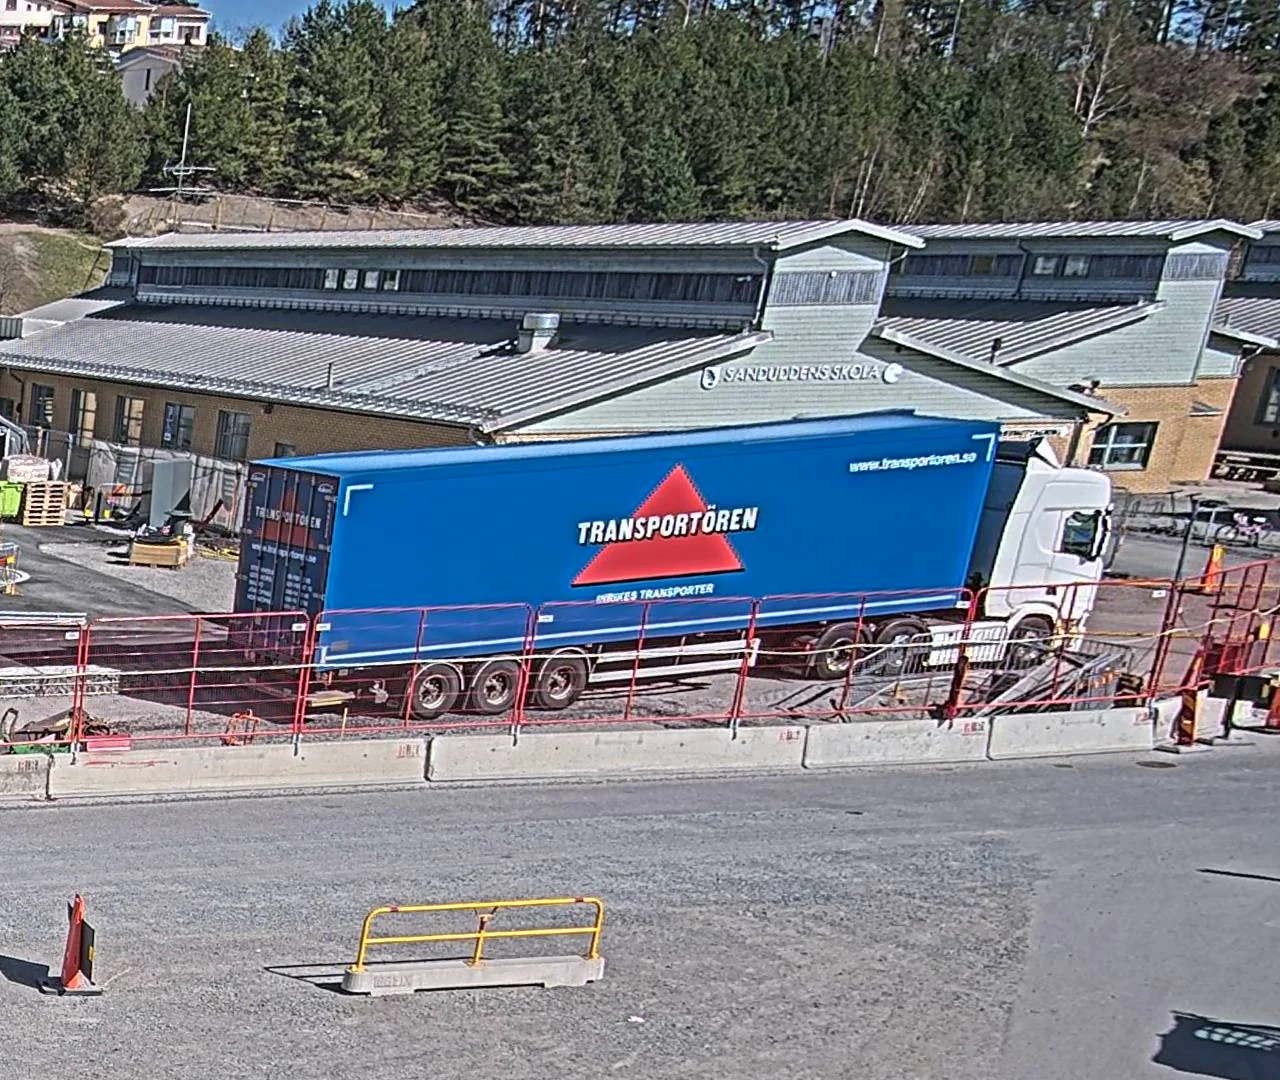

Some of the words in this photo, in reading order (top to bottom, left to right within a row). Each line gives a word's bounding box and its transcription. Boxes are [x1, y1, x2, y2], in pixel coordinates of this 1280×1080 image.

[830, 364, 879, 381] SKOLA
[578, 505, 759, 545] TRANSPORTÖREN
[640, 583, 714, 600] TRANSPORTER
